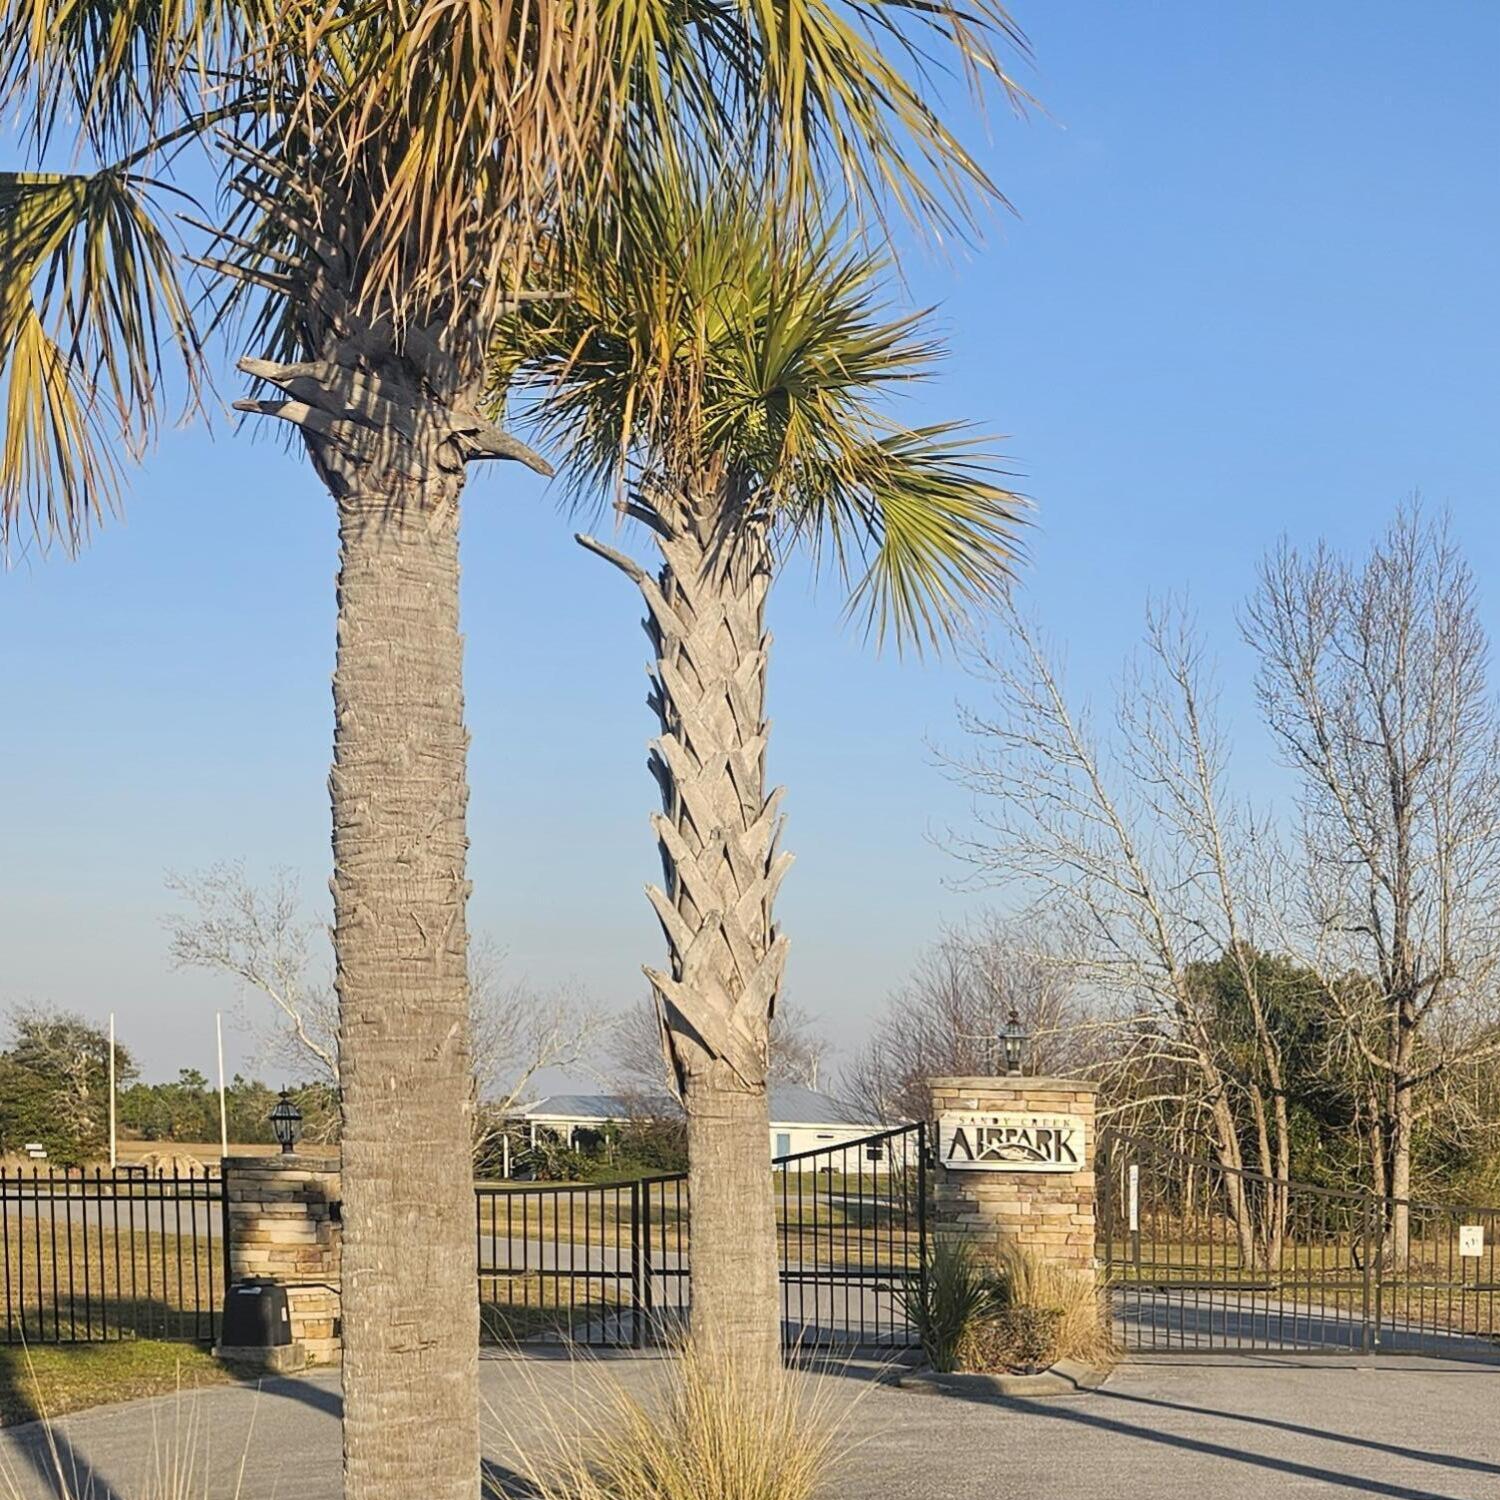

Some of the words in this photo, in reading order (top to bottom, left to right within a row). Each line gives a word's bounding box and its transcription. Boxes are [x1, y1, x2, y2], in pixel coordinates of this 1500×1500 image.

[959, 1117, 1010, 1126] SANDY
[1021, 1118, 1071, 1127] CREEK
[946, 1127, 1078, 1163] AIRPARK
